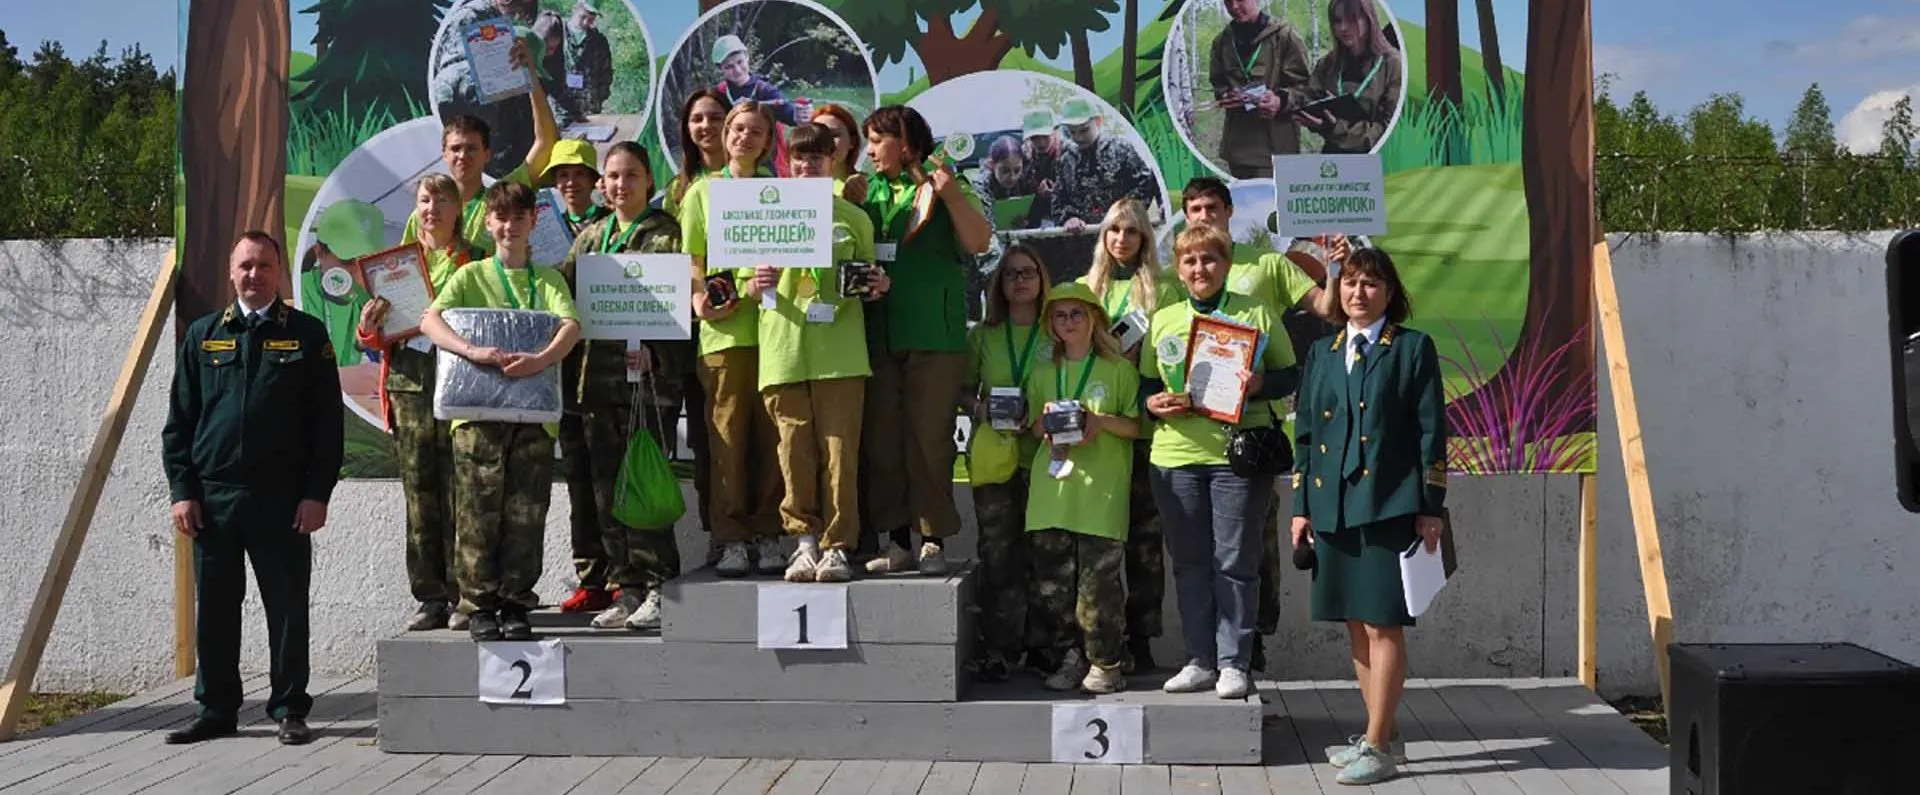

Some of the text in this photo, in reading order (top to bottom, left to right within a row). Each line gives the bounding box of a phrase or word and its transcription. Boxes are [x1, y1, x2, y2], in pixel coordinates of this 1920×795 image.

[1287, 196, 1376, 214] «ЛЕСОВИЧОК»
[723, 221, 816, 244] «БЕРЕНДЕЙ»
[591, 300, 634, 313] «ЛЕСНАЯ
[792, 602, 812, 644] 1
[510, 659, 533, 699] 2
[1084, 718, 1109, 759] 3
